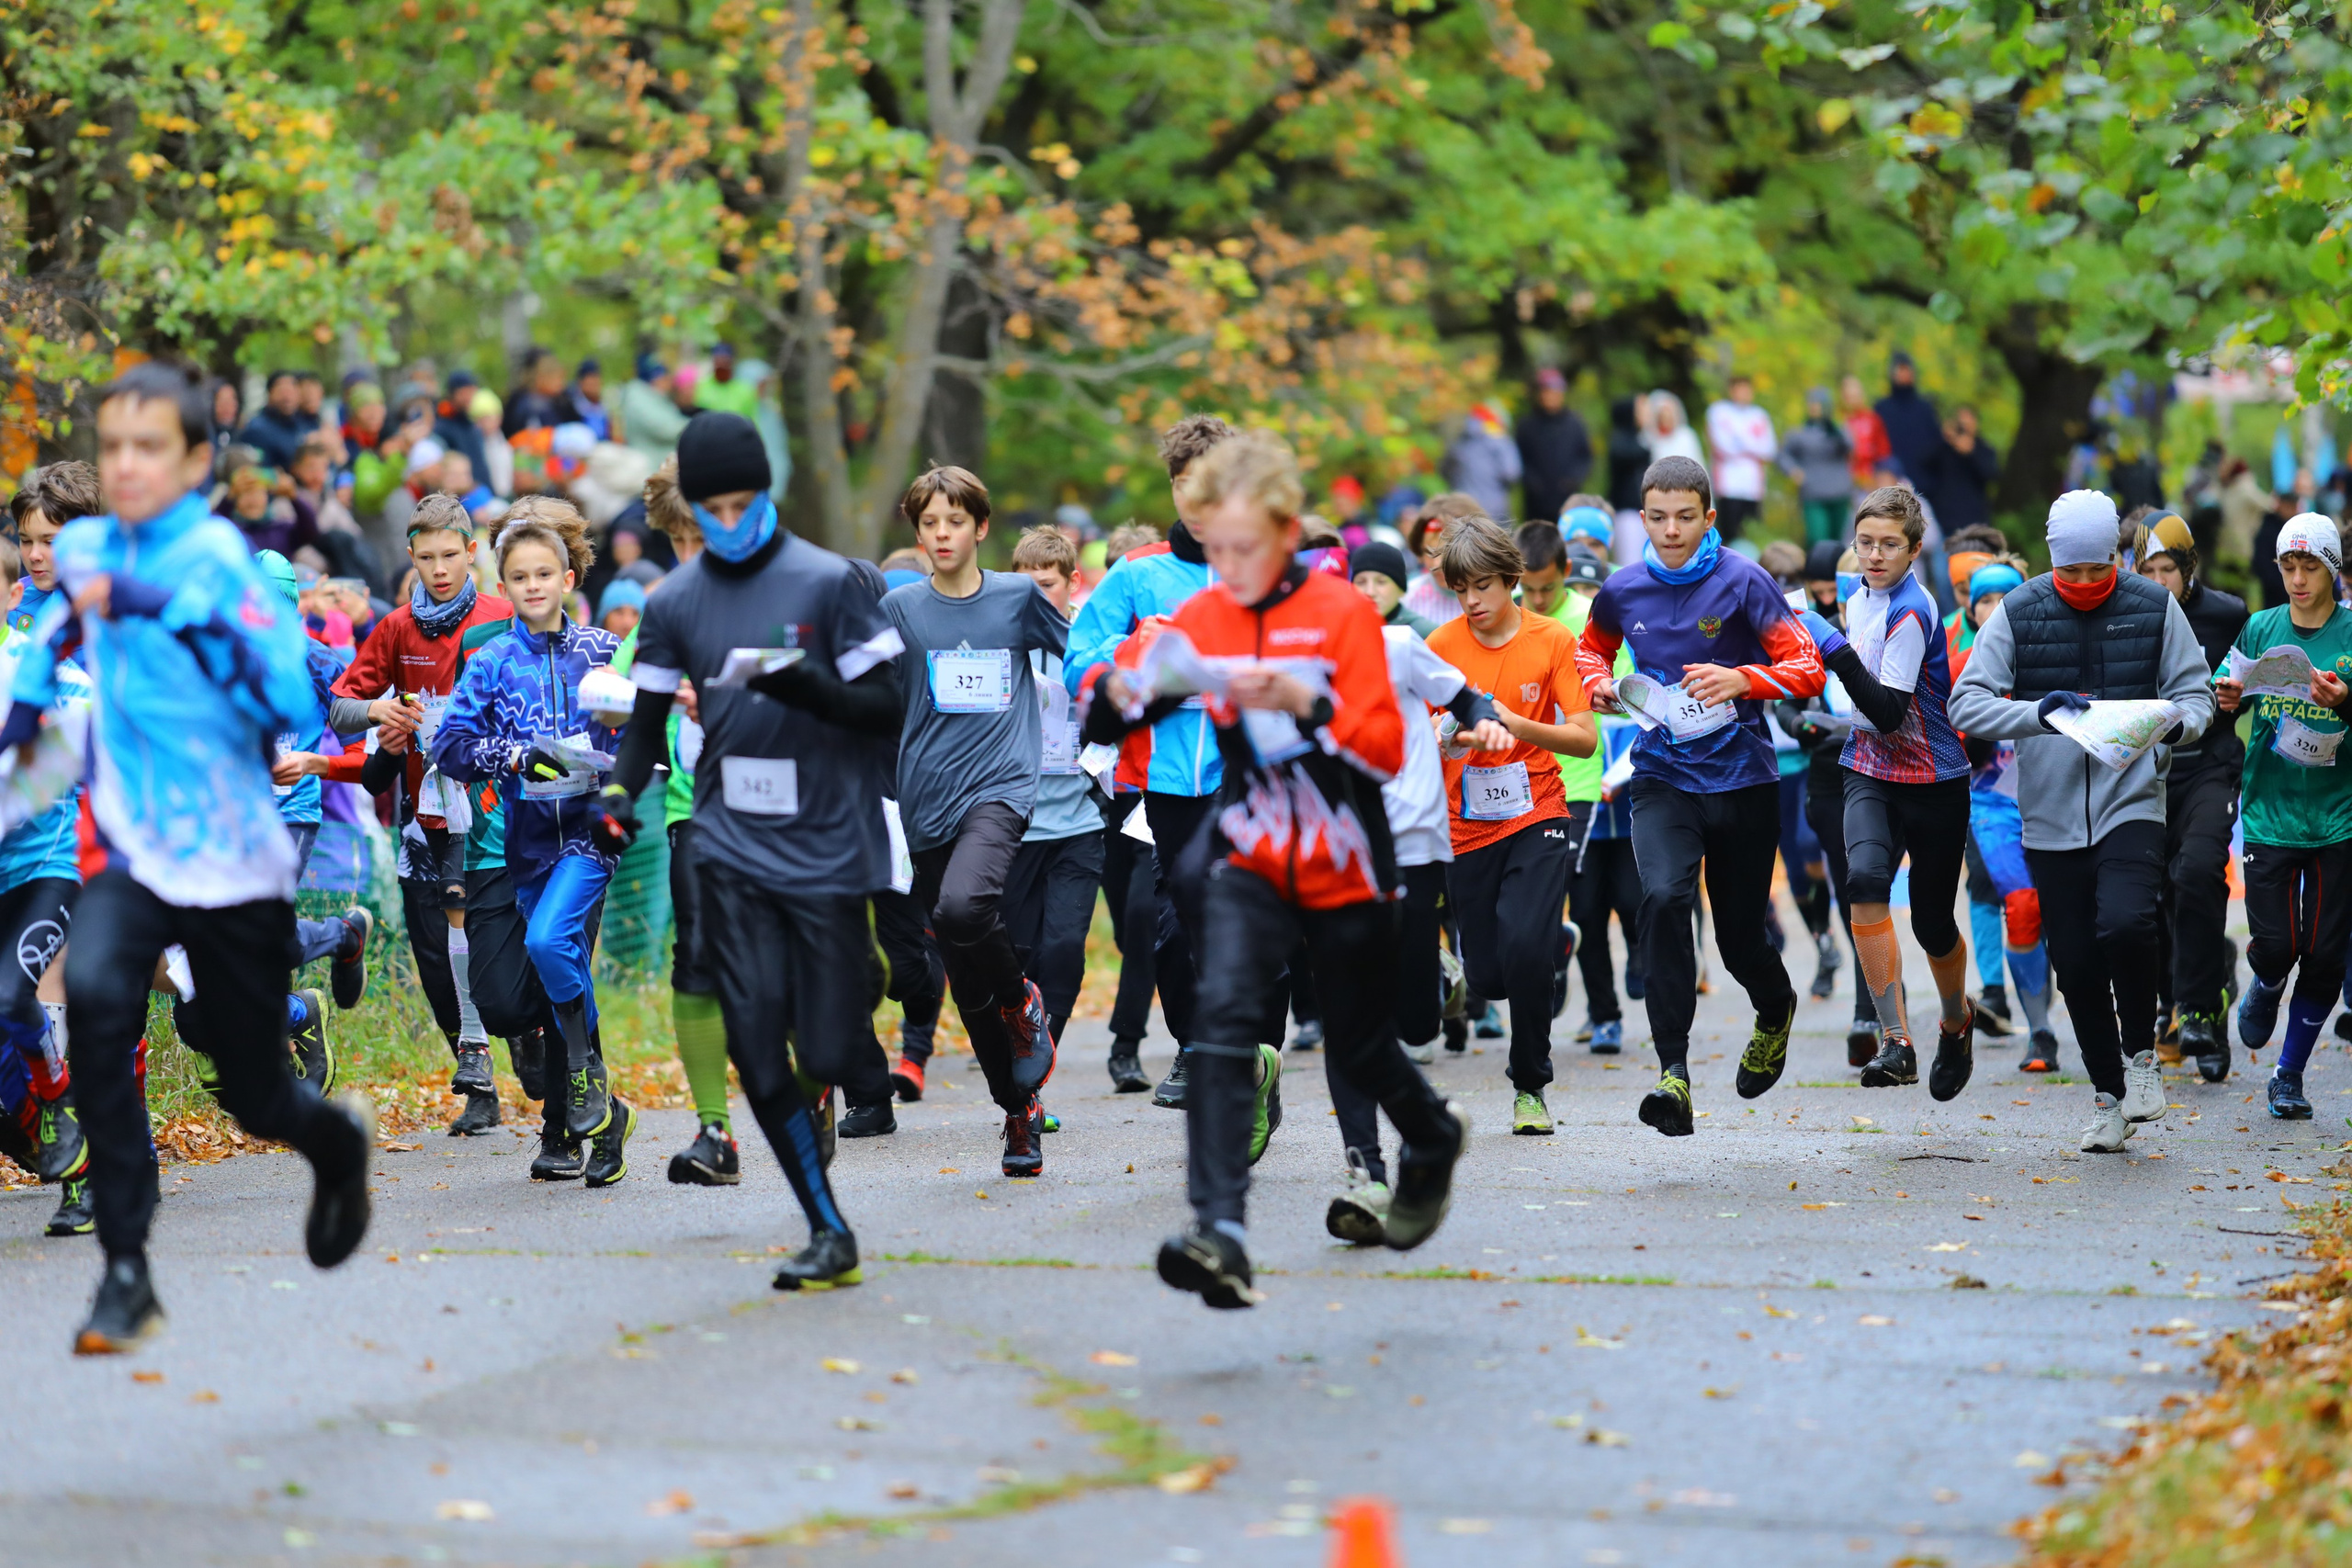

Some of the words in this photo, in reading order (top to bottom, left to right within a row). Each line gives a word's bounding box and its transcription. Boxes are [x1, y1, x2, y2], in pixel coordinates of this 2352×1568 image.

[955, 675, 984, 690] 327
[1519, 682, 1542, 704] 10
[1679, 702, 1705, 720] 351
[2293, 738, 2318, 753] 320
[1485, 785, 1510, 801] 326
[1544, 829, 1566, 839] FILA
